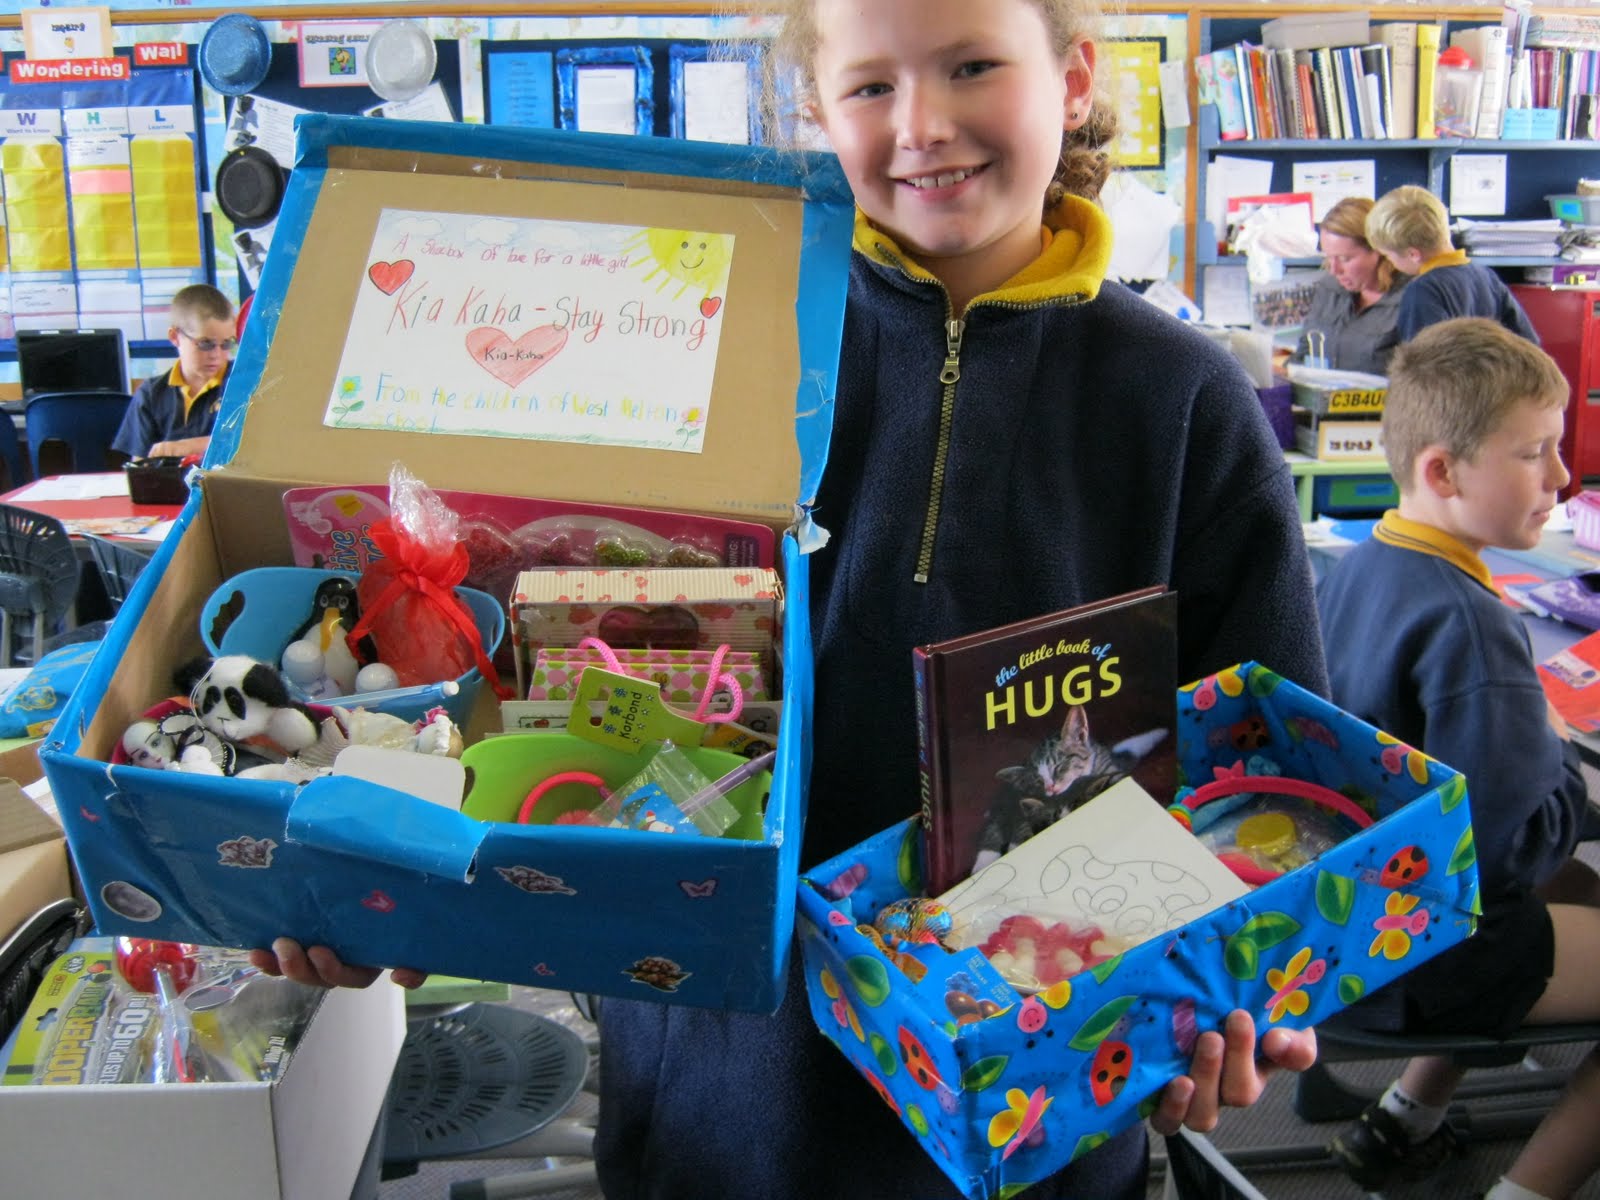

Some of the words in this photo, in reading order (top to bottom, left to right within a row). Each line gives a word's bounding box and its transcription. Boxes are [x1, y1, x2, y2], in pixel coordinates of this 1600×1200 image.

[17, 61, 124, 78] Wondering
[140, 43, 183, 61] Wall
[17, 112, 36, 125] W
[87, 111, 100, 125] H
[155, 109, 166, 122] L
[392, 232, 410, 253] A
[506, 248, 528, 263] love
[580, 253, 605, 266] little
[608, 255, 629, 274] girl
[386, 279, 445, 336] Kia
[454, 286, 521, 326] Kaha
[552, 296, 604, 343] Stay
[618, 300, 708, 351] Strong
[432, 384, 457, 408] the
[464, 389, 539, 412] children
[550, 391, 570, 413] of
[573, 393, 609, 417] West
[995, 665, 1019, 687] the
[1019, 644, 1054, 670] little
[1055, 638, 1091, 656] book
[1091, 643, 1112, 661] of
[985, 656, 1122, 731] HUGS
[619, 691, 643, 739] Korbond
[920, 770, 932, 832] HUGS
[112, 1008, 151, 1040] 60
